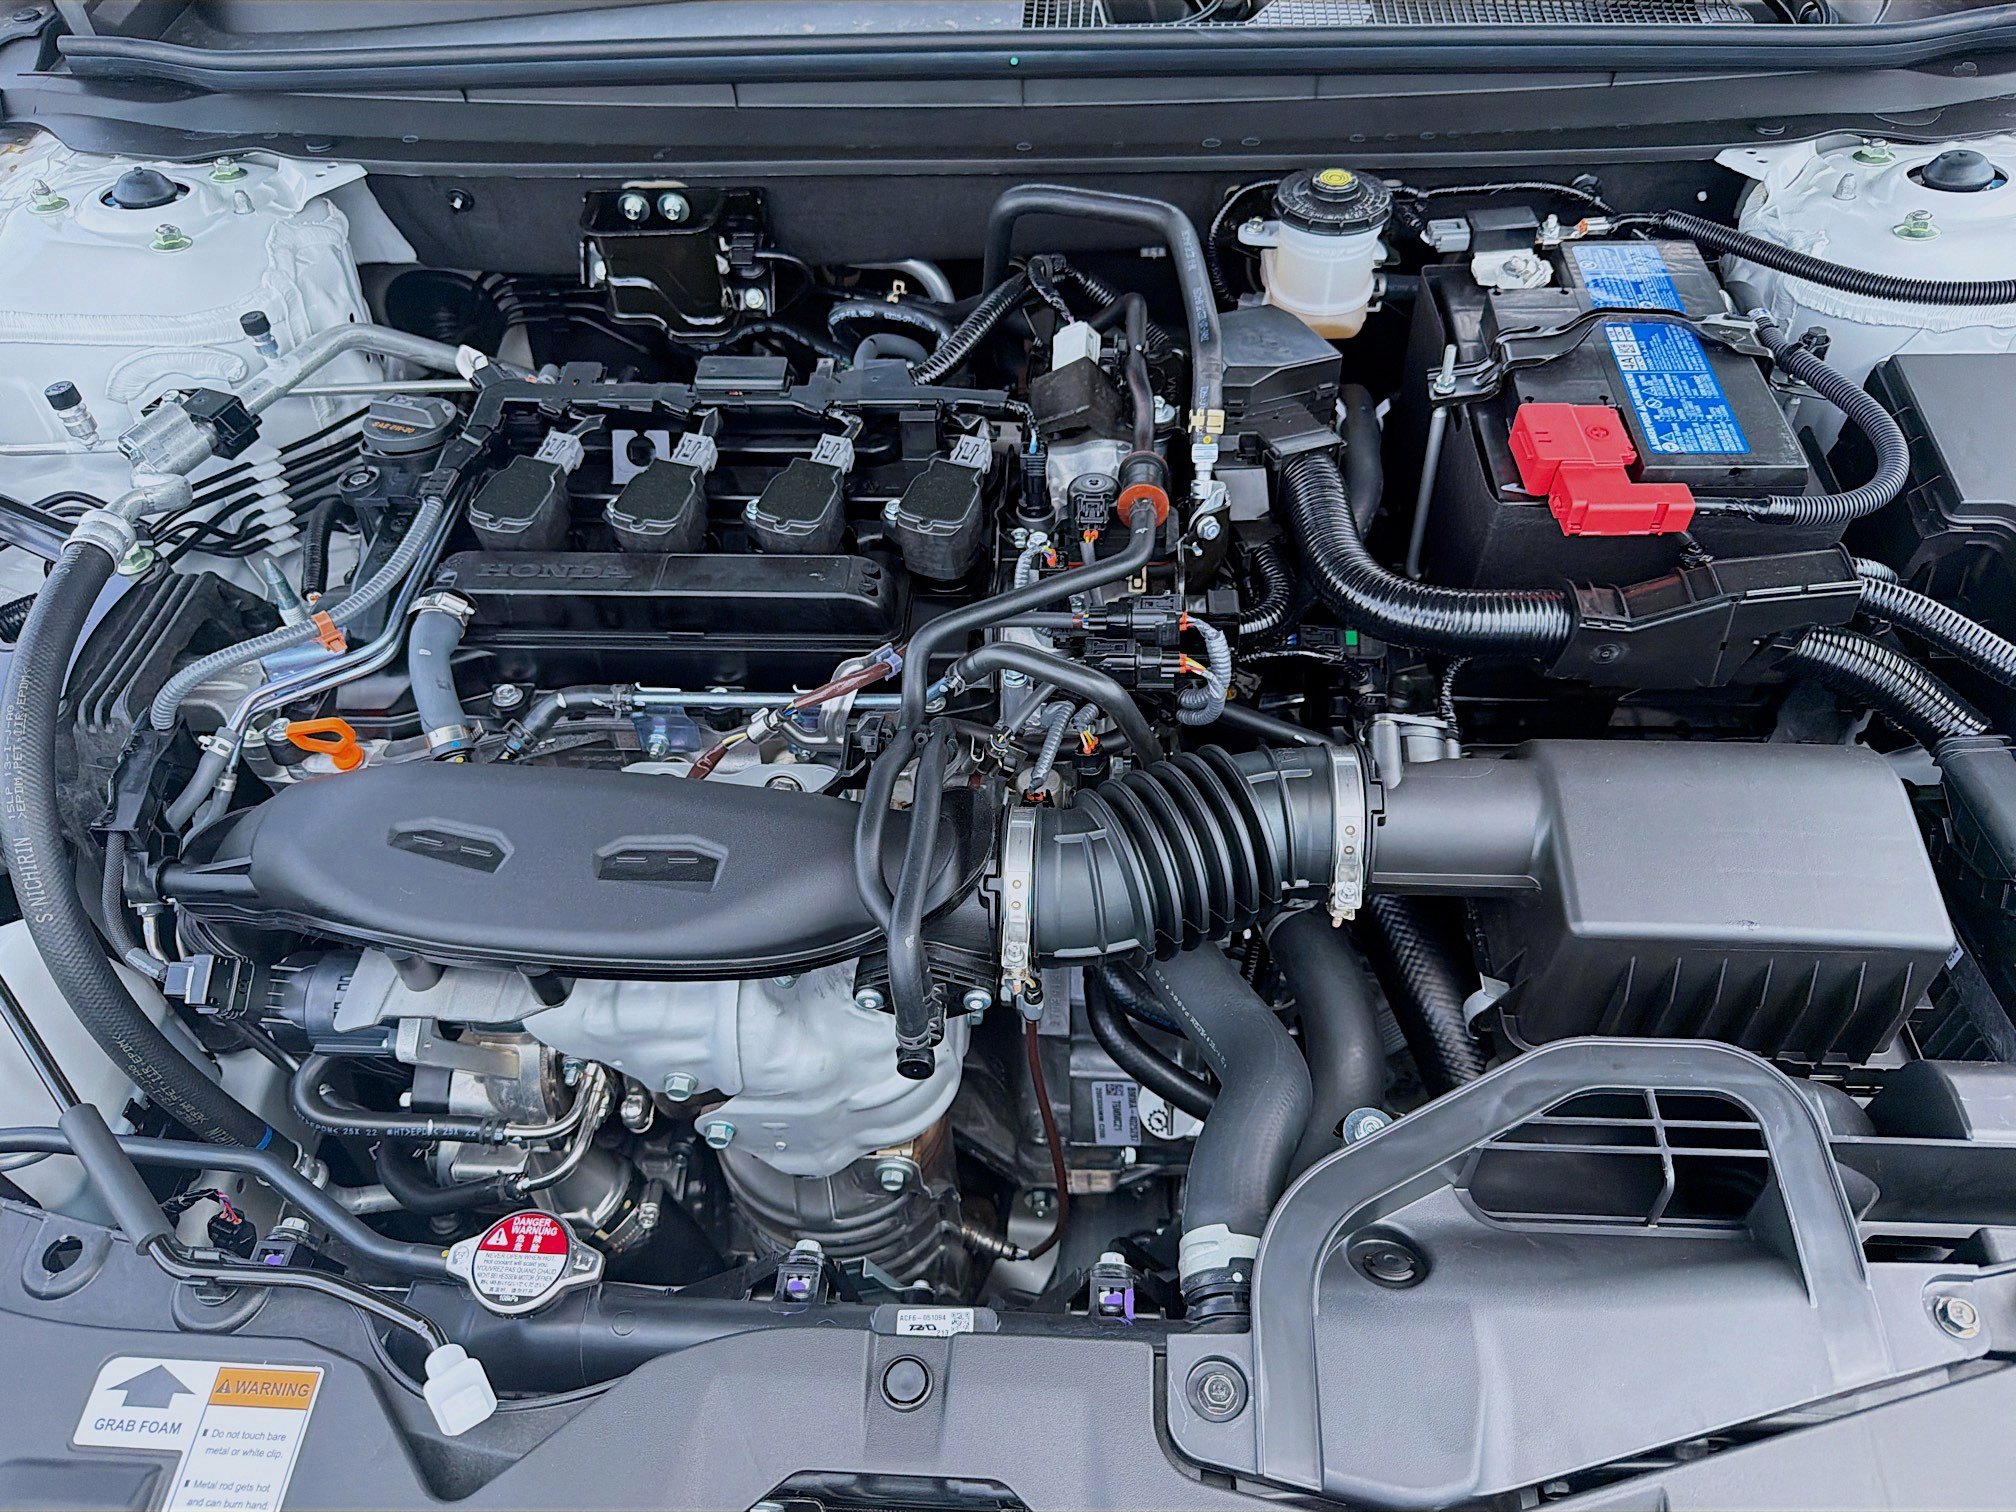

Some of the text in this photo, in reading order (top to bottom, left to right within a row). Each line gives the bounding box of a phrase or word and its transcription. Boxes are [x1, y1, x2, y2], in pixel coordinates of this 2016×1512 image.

[476, 563, 632, 579] HONDA
[513, 1216, 552, 1227] DANGER
[511, 1225, 558, 1236] WARNUNG
[236, 1380, 310, 1398] WARNING
[94, 1418, 183, 1435] GRAB FOAM
[211, 1428, 287, 1442] Do not touch bare
[205, 1446, 283, 1460] metal or white clip.
[194, 1480, 271, 1493] Metal rod gets hot
[186, 1498, 204, 1508] and
[207, 1500, 221, 1508] can
[223, 1499, 243, 1509] burn
